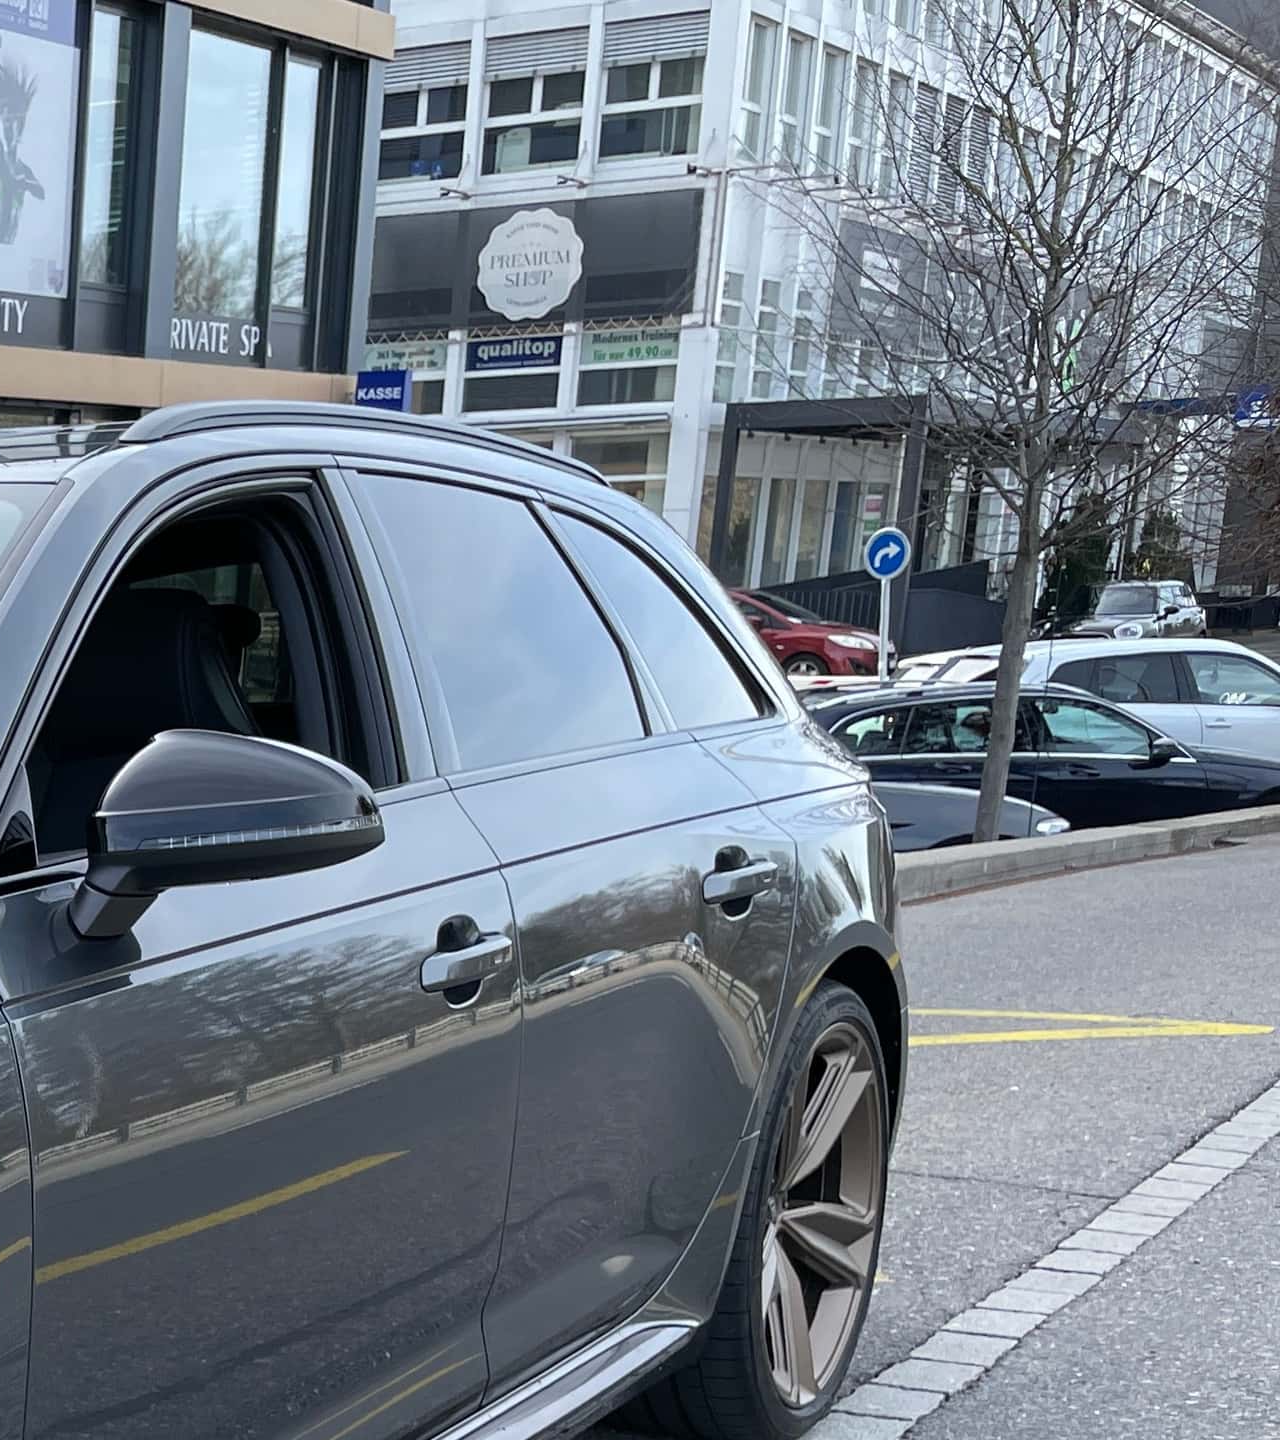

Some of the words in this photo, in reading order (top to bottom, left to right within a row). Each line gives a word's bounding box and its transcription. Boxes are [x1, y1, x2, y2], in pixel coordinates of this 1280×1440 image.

[489, 249, 571, 270] PREMIUM
[504, 270, 553, 288] SHOP
[477, 340, 556, 360] qualitop
[357, 387, 402, 401] KASSE
